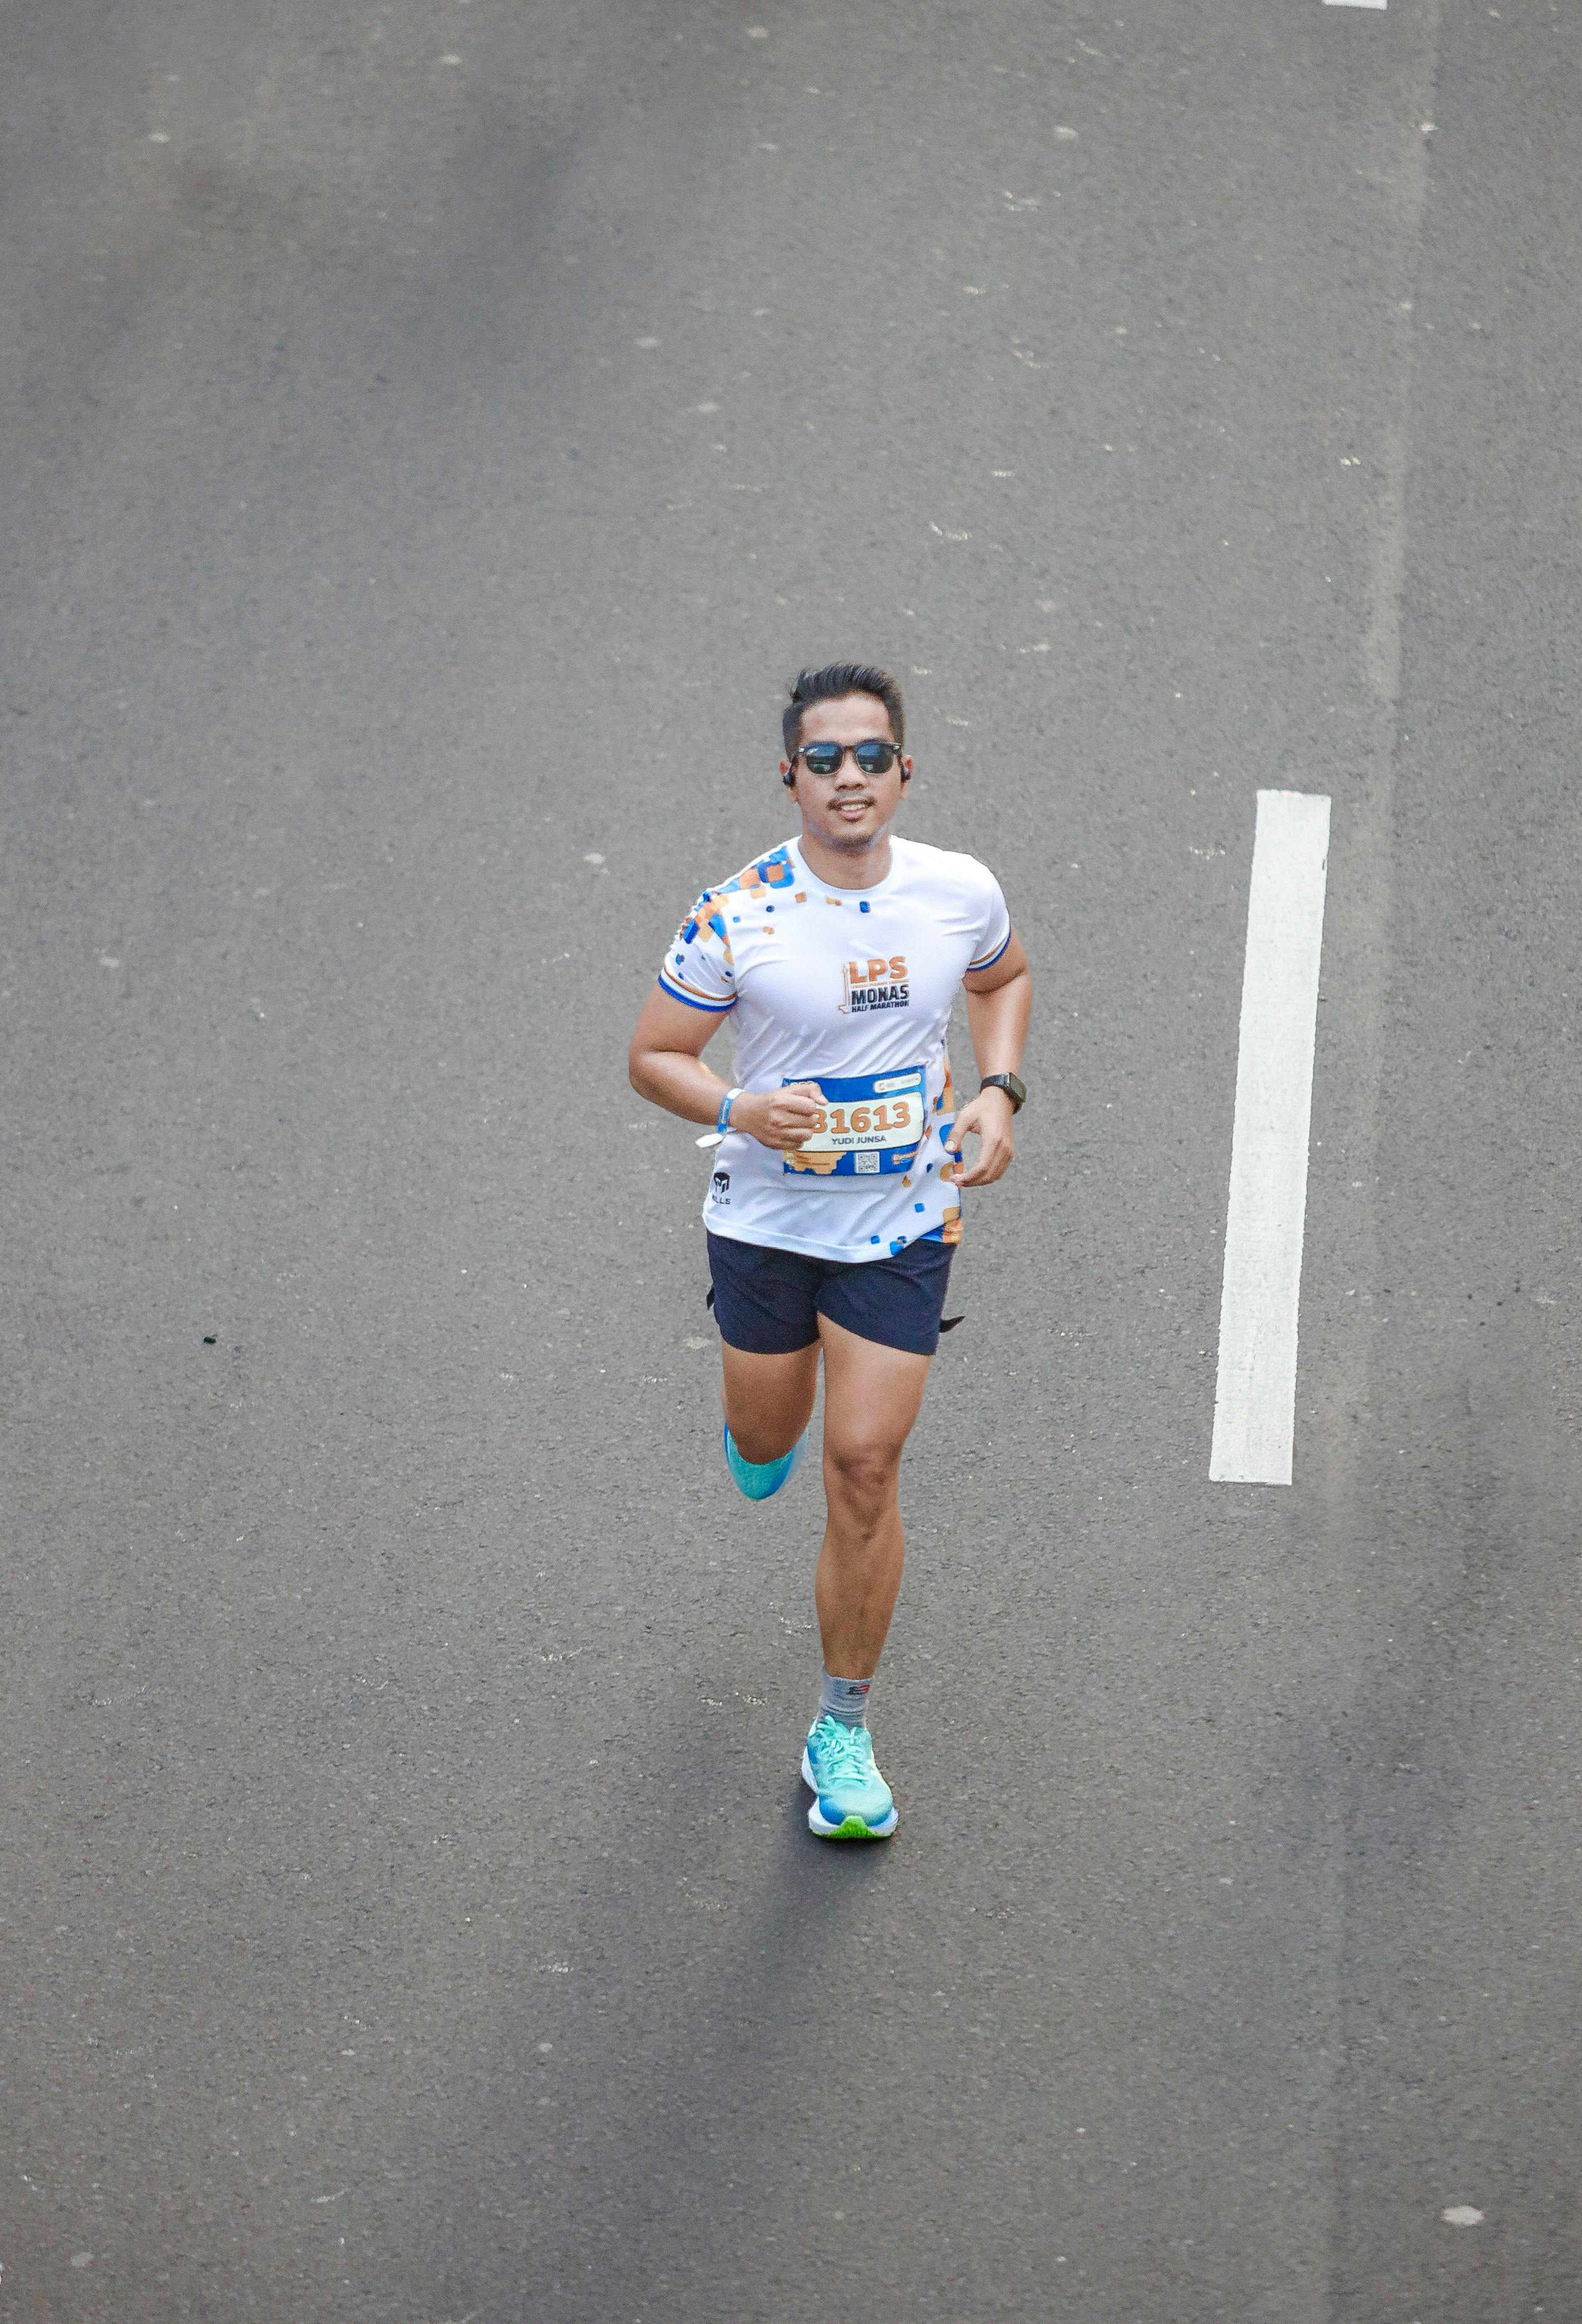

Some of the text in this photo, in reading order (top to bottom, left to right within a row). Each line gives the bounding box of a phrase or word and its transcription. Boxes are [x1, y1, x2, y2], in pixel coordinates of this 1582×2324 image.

[848, 955, 908, 984] LPS
[852, 984, 909, 1005] MONAS
[852, 1000, 909, 1013] HALF MARATHON
[810, 1101, 911, 1134] 31613
[857, 1134, 887, 1144] JUNSA
